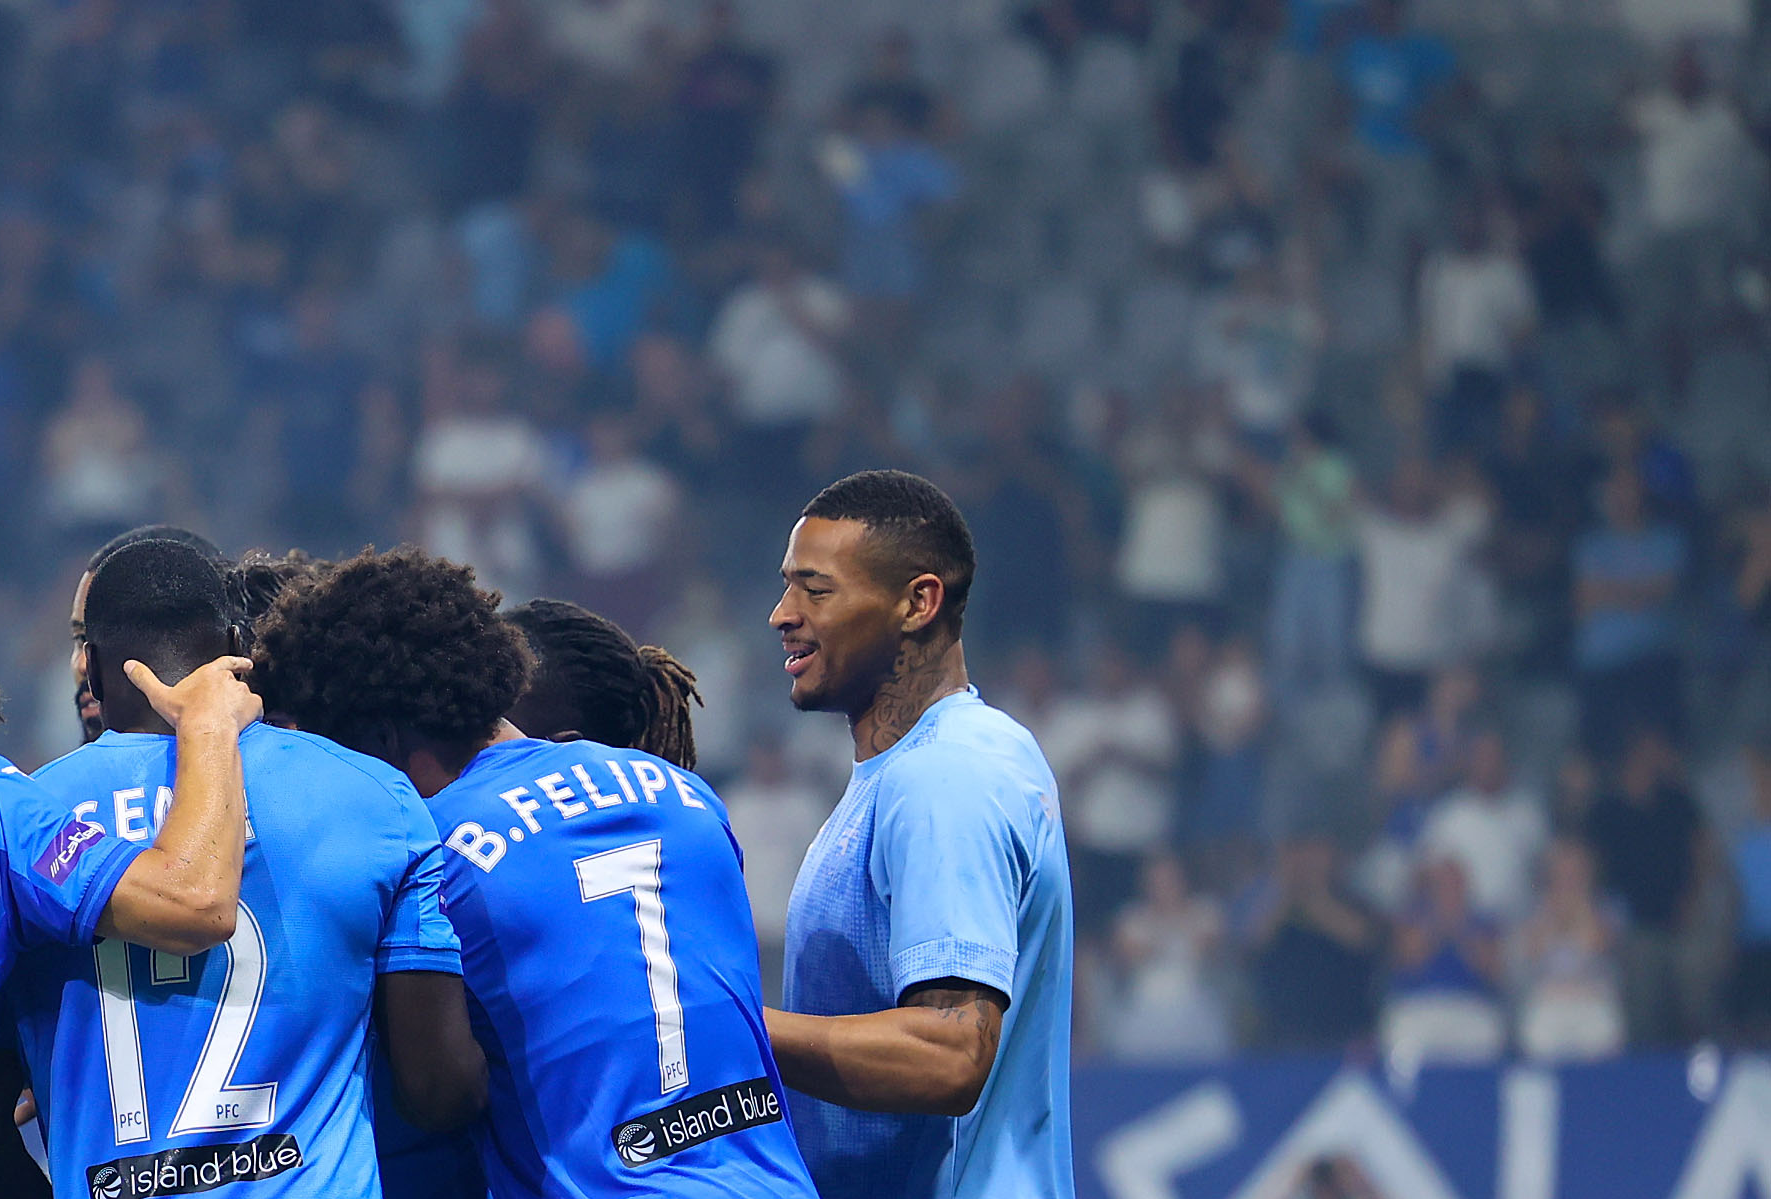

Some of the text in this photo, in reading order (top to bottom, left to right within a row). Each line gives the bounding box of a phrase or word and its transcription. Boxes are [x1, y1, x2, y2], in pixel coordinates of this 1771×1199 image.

[445, 760, 706, 873] B.FELIPE
[573, 839, 688, 1094] 7
[93, 899, 278, 1146] 12
[665, 1062, 684, 1080] PFC
[119, 1110, 143, 1128] PFC
[215, 1102, 239, 1119] PFC
[660, 1086, 779, 1147] island blue
[130, 1142, 298, 1196] island blue
